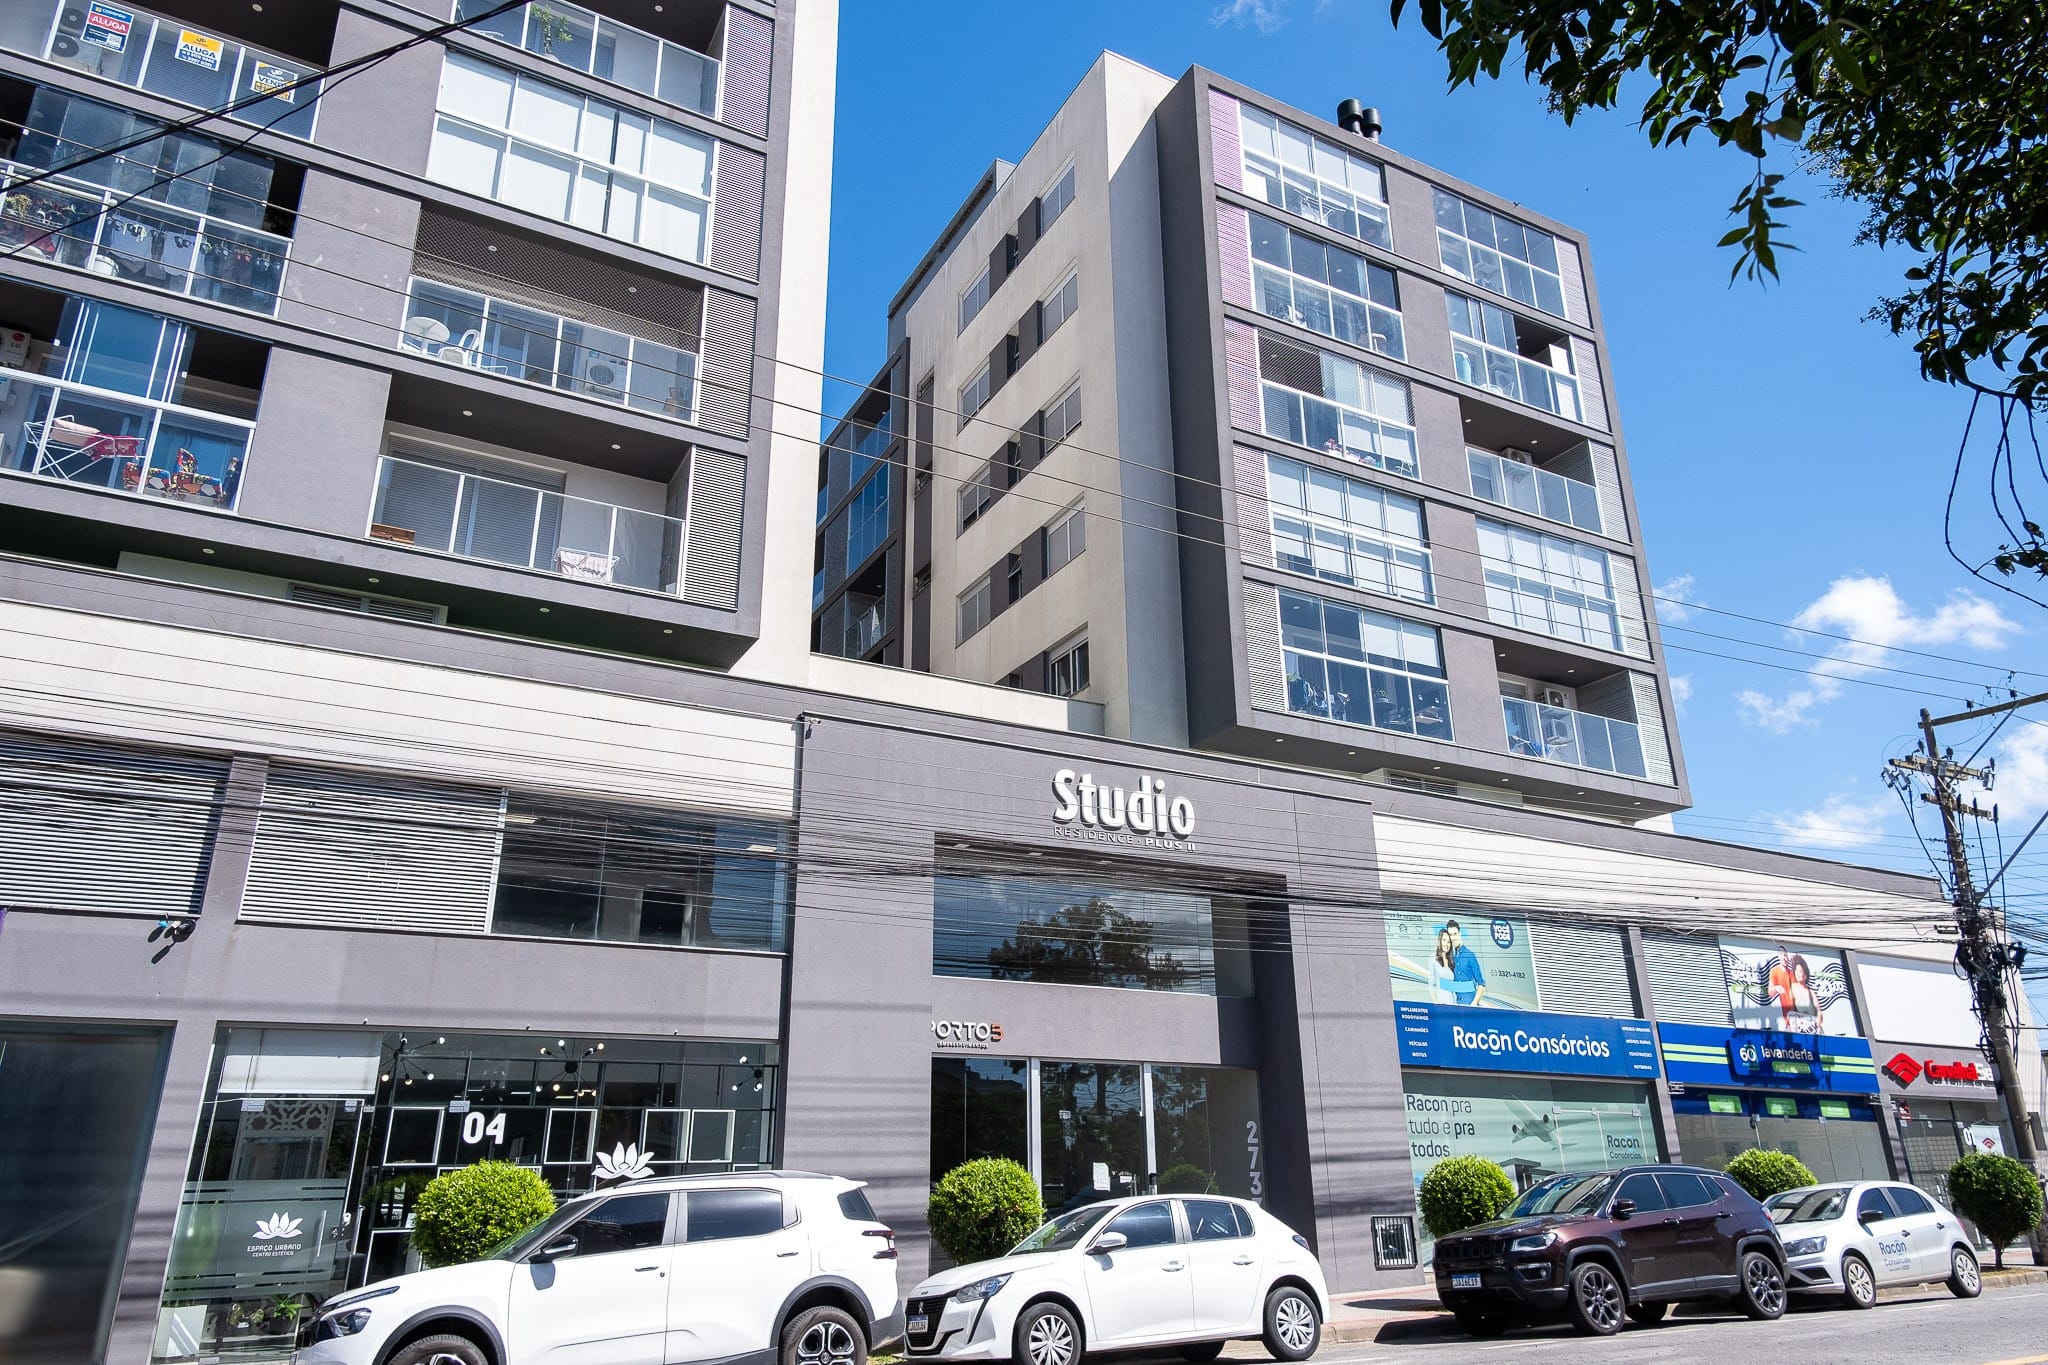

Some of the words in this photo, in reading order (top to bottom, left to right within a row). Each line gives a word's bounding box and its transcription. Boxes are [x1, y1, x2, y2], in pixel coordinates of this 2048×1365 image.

[91, 15, 127, 32] ALUGA
[182, 43, 217, 59] ALUGA
[1053, 768, 1196, 839] Studio
[1054, 826, 1134, 845] RESIDENCE
[1145, 837, 1183, 851] PLUS
[1514, 1030, 1610, 1058] Consórcios
[1760, 1045, 1814, 1061] lavanderia
[1406, 1095, 1448, 1112] Racon
[1451, 1100, 1472, 1117] pra
[463, 1111, 506, 1145] 04
[1408, 1117, 1440, 1135] tudo
[1442, 1122, 1451, 1135] e
[1454, 1122, 1475, 1140] pra
[1411, 1140, 1451, 1158] todos
[1606, 1134, 1640, 1149] Racon
[274, 1243, 302, 1251] URBANO
